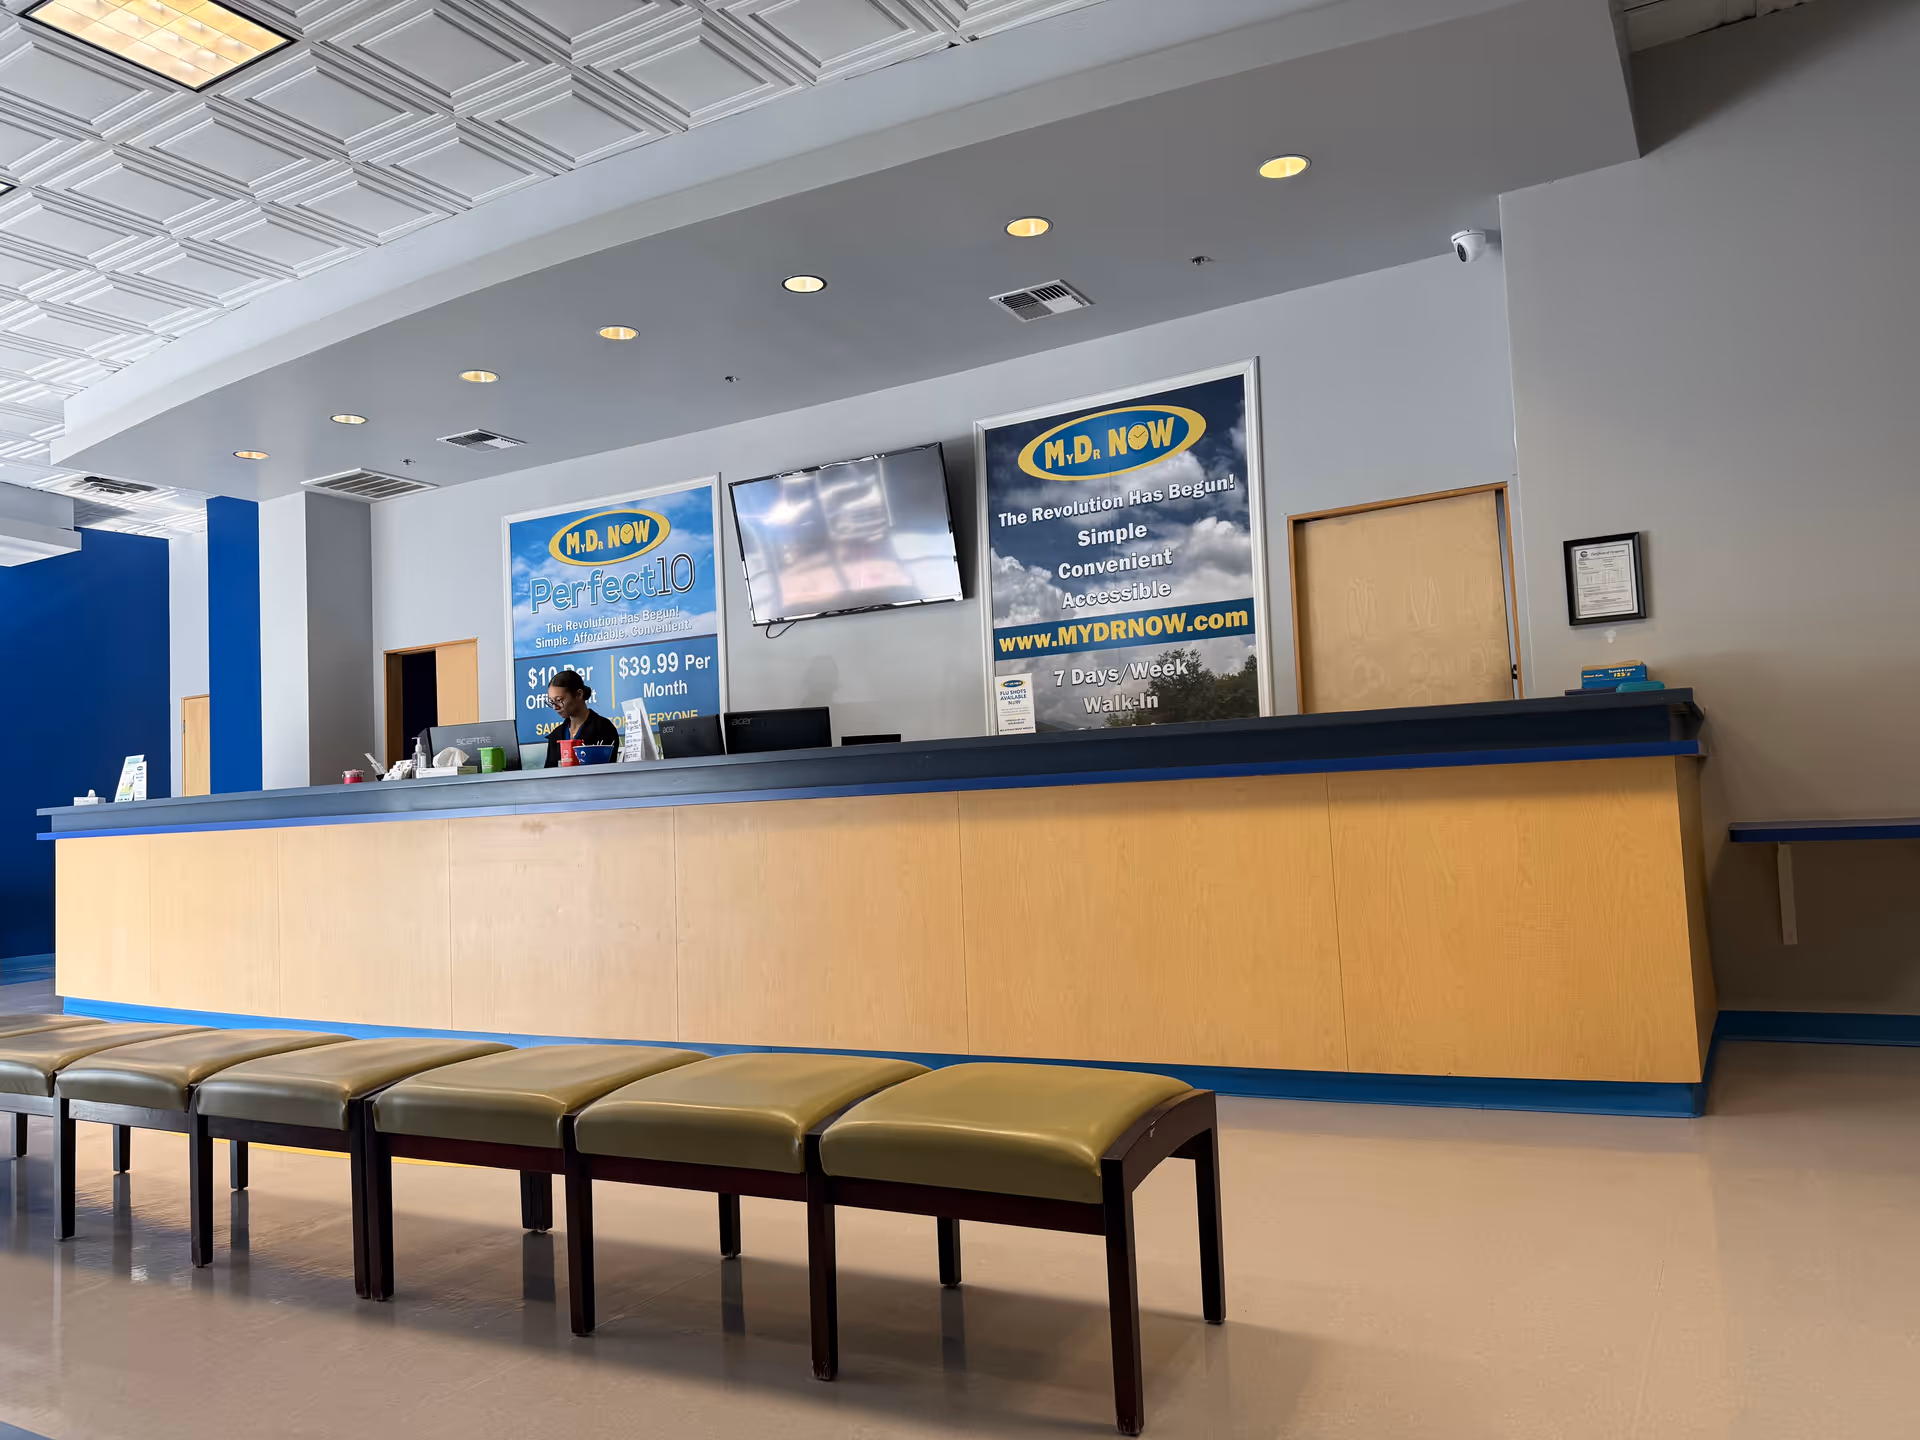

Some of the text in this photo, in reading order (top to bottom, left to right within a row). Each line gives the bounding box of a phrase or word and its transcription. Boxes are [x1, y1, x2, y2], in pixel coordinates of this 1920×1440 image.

[1108, 417, 1175, 458] NOW
[998, 474, 1235, 528] The Revolution Has Begun!
[607, 519, 651, 548] NOW
[1077, 522, 1148, 547] Simple
[1058, 548, 1173, 580] Convenient
[1061, 580, 1172, 609] Accessible
[545, 606, 680, 634] The Revolution Has Begun!
[999, 610, 1248, 653] www.MYDRNOW.com
[535, 620, 693, 649] Simple. Affordable. Convenient.
[618, 651, 711, 679] $39.99 Per
[1054, 659, 1189, 687] 7 Days/Week
[643, 680, 688, 698] Month
[1083, 692, 1159, 714] Walk-In
[536, 721, 564, 736] SAM
[662, 725, 675, 734] acer
[731, 717, 752, 726] acer
[456, 736, 491, 746] SCEPTRE
